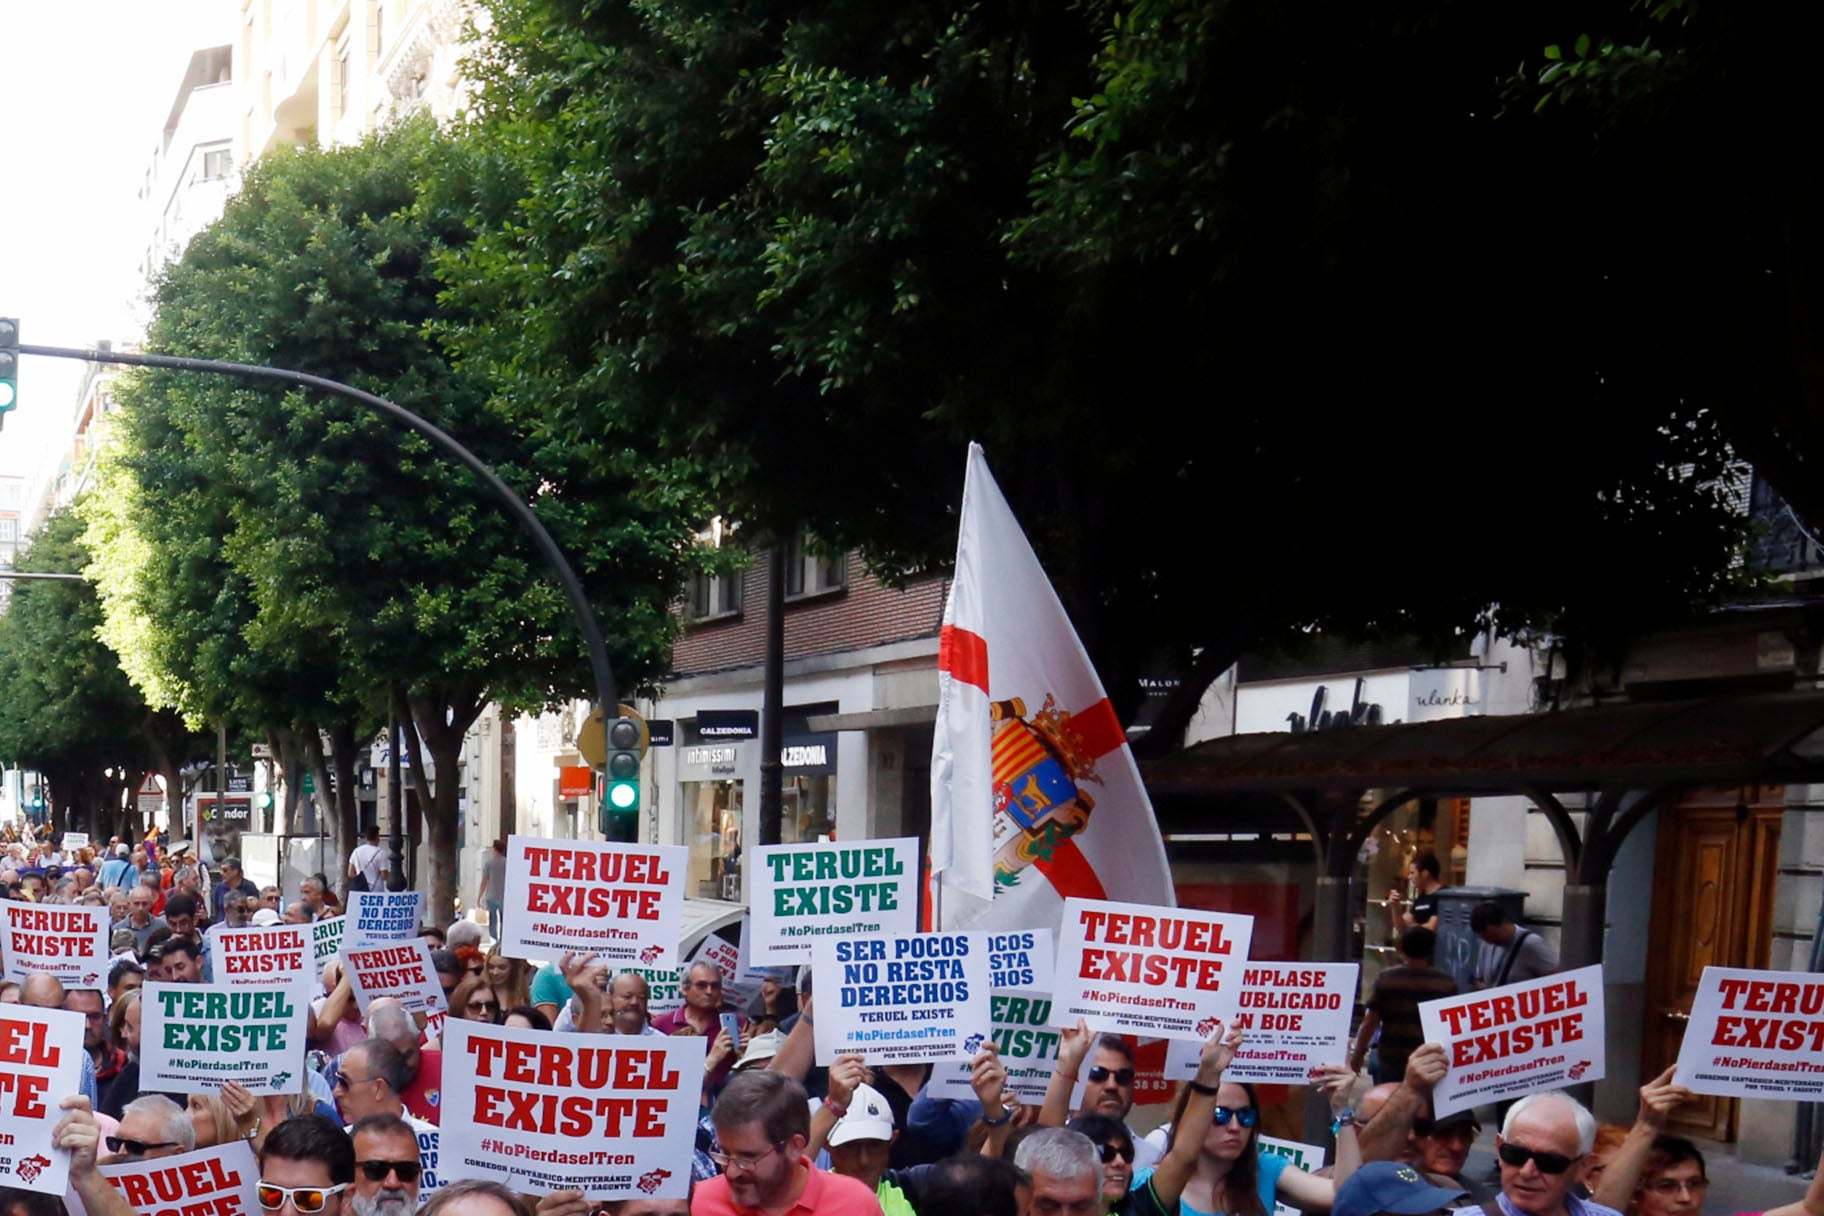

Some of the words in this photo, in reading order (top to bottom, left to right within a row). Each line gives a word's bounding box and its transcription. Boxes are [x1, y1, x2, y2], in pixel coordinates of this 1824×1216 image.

[700, 727, 752, 735] CALZEDONIA
[211, 808, 248, 820] Cndor
[524, 847, 669, 885] TERUEL
[767, 848, 903, 882] TERUEL
[360, 895, 383, 906] SER
[388, 894, 419, 906] POCOS
[527, 883, 661, 920] EXISTE
[774, 882, 898, 916] EXISTE
[8, 907, 98, 932] TERUEL
[362, 907, 378, 918] NO
[382, 907, 414, 918] RESTA
[358, 919, 413, 931] DERECHOS
[532, 923, 638, 940] #NoPierdaselTren
[780, 923, 880, 937] #NoPierdaselTren
[1080, 910, 1232, 955] TERUEL
[12, 932, 93, 956] EXISTE
[220, 931, 305, 952] TERUEL
[836, 940, 886, 961] SER
[895, 936, 968, 959] POCOS
[225, 952, 302, 973] EXISTE
[348, 946, 423, 970] TERUEL
[1079, 948, 1222, 991] EXISTE
[358, 966, 426, 990] EXISTE
[845, 963, 878, 984] NO
[888, 959, 965, 982] RESTA
[989, 969, 1033, 987] HOS
[1243, 969, 1326, 987] MPLASE
[158, 991, 294, 1019] TERUEL
[841, 982, 969, 1007] DERECHOS
[1082, 990, 1196, 1011] #NoPierdaselTren
[1239, 992, 1341, 1010] UBLICADO
[860, 1011, 907, 1022] TERUEL
[912, 1008, 954, 1020] EXISTE
[1440, 981, 1587, 1036] TERUEL
[1235, 1013, 1253, 1029] N
[1260, 1014, 1303, 1031] BOE
[163, 1023, 287, 1052] EXISTE
[847, 1028, 956, 1041] #NoPierdaselTren
[1452, 1013, 1583, 1068] EXISTE
[169, 1059, 268, 1071] #NoPierdaselTren
[467, 1036, 679, 1090] TERUEL
[1459, 1055, 1565, 1084] #NoPierdaselTren
[473, 1085, 668, 1138] EXISTE
[481, 1138, 635, 1165] #NoPierdaselTren
[464, 1158, 508, 1172] CORREDOR
[529, 1178, 546, 1187] POR
[591, 1183, 631, 1191] SAGUNTO
